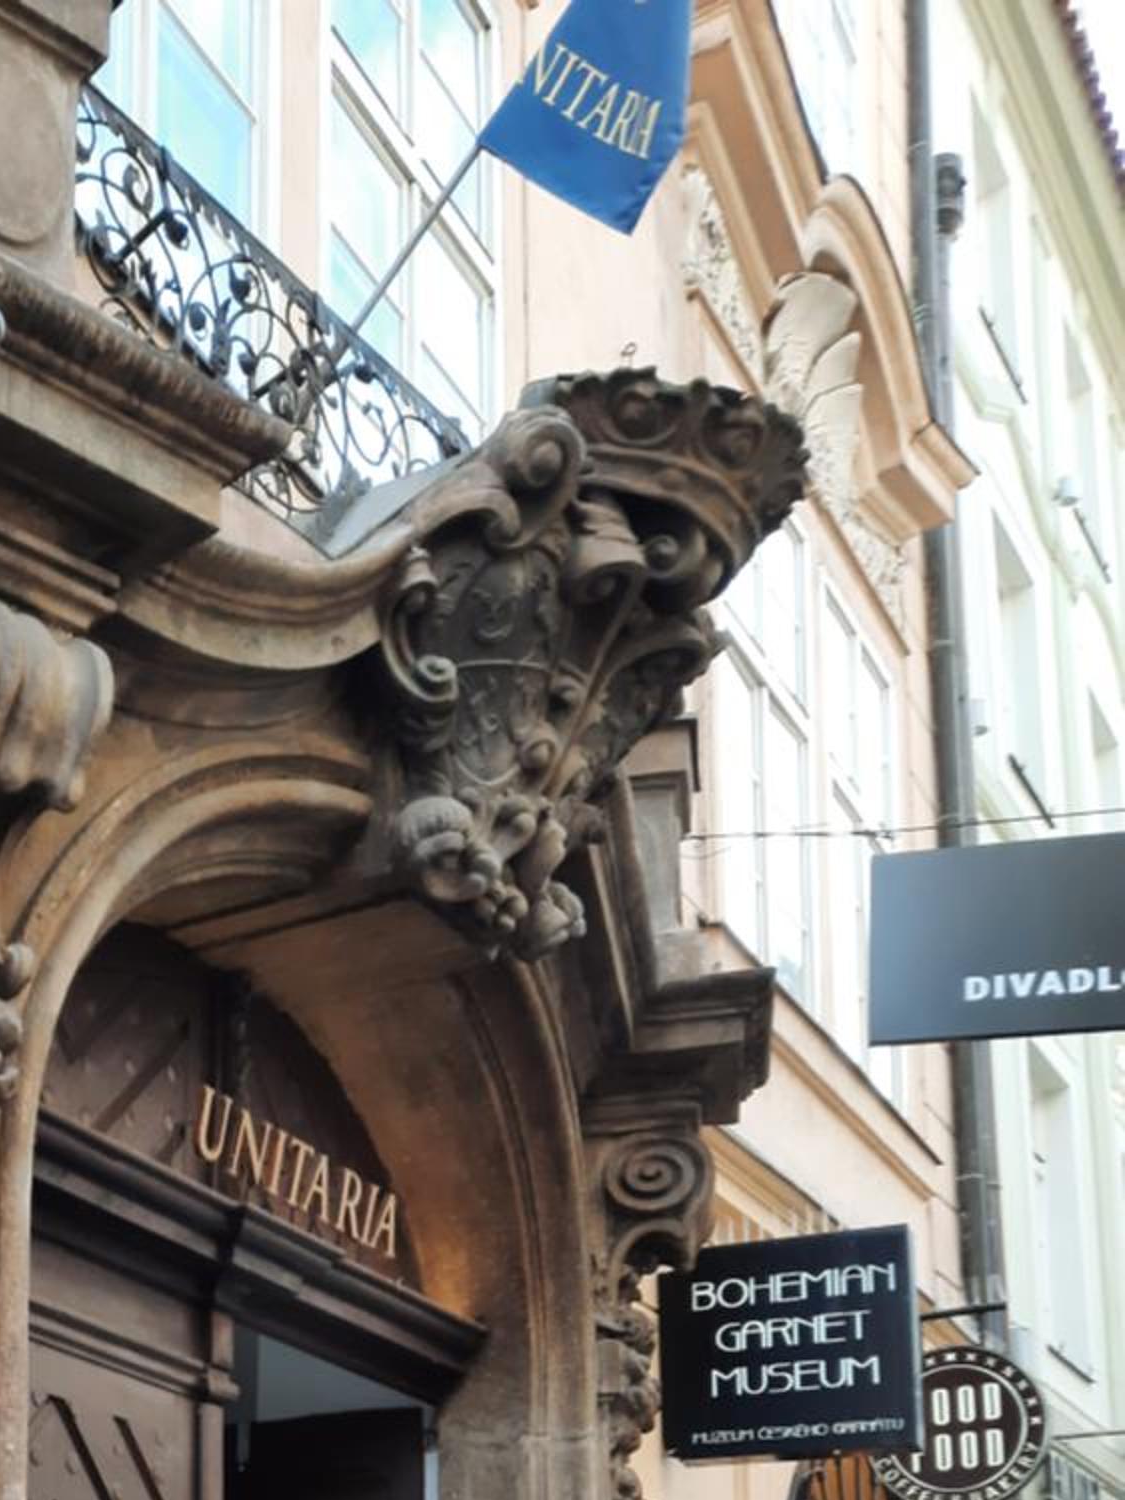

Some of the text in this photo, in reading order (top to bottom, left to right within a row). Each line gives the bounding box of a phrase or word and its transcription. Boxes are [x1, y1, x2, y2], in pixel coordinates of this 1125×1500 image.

[963, 965, 1125, 1002] DIVADL
[198, 1084, 396, 1258] UNITARIA
[691, 1262, 896, 1312] BOHEMIAN
[714, 1309, 871, 1353] GARNET
[710, 1354, 881, 1398] MUSEUM
